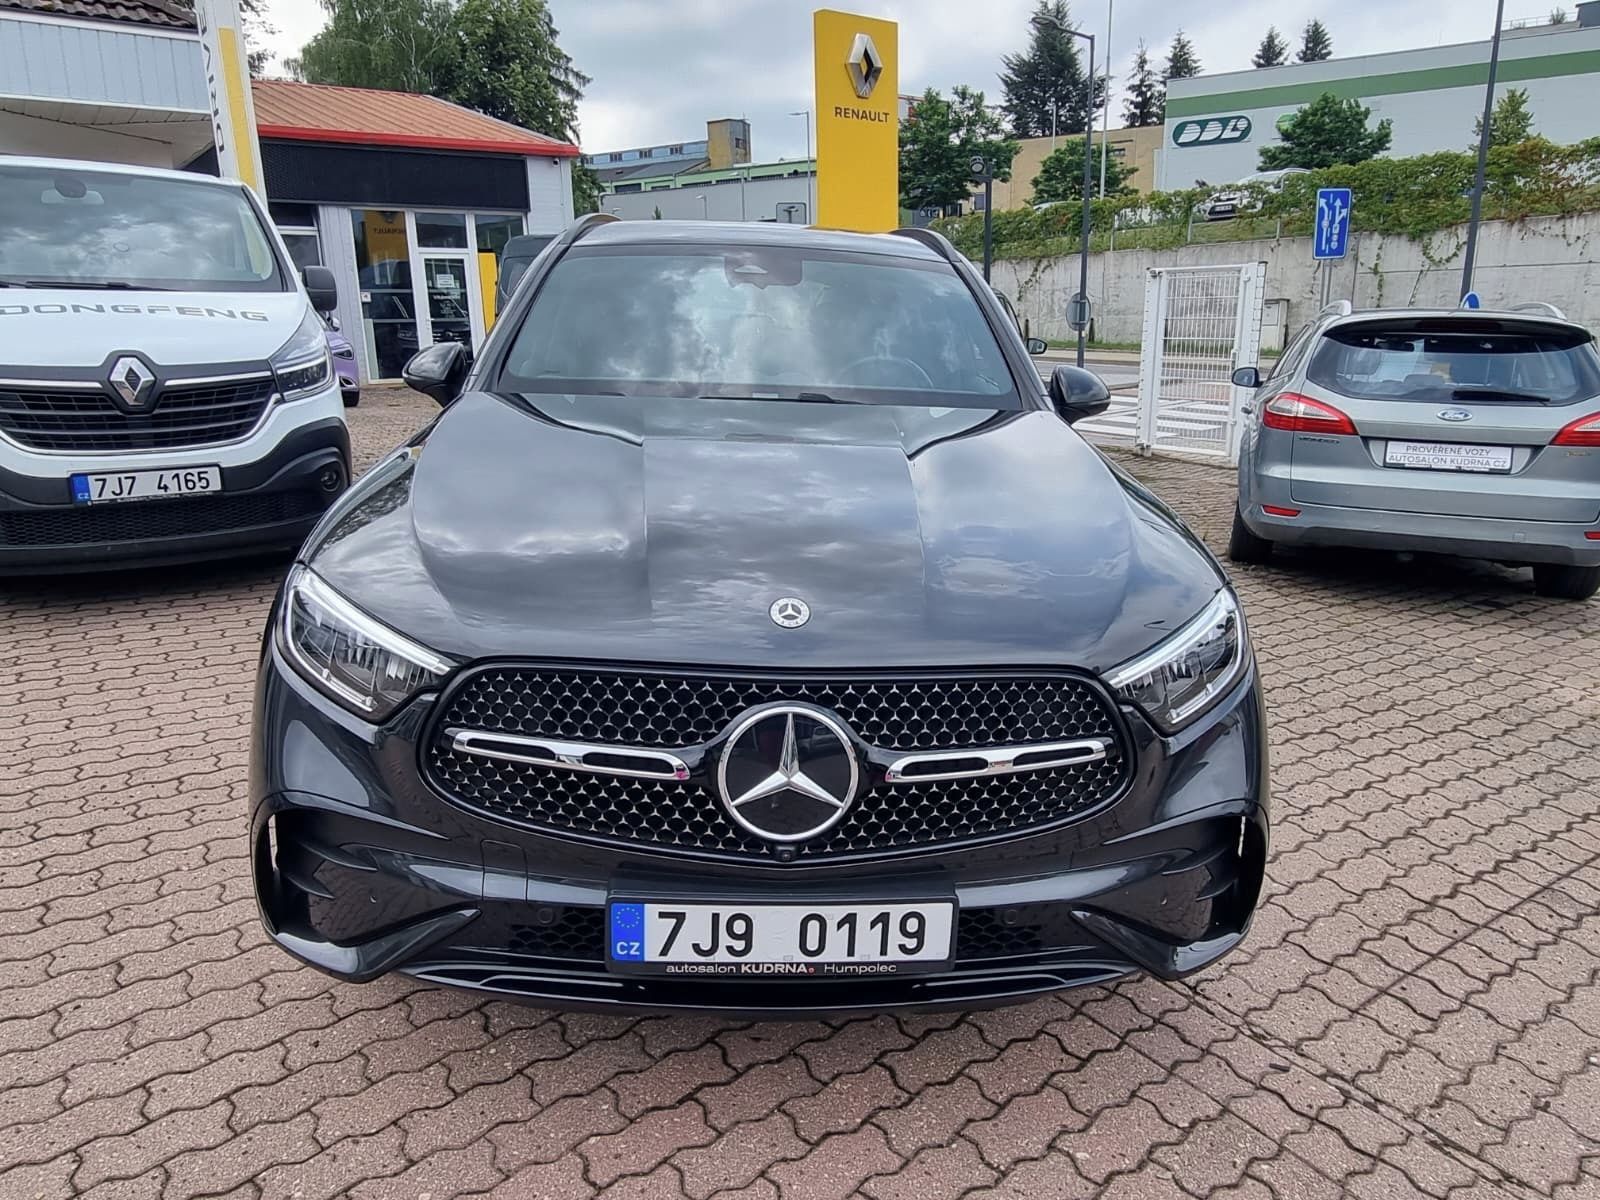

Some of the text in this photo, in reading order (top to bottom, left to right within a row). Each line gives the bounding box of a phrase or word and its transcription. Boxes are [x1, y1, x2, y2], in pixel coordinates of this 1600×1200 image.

[834, 106, 890, 123] RENAULT
[0, 304, 269, 322] DONGFENG
[1388, 455, 1447, 464] AUTOSALON
[1449, 457, 1490, 467] KUDRNA
[94, 470, 210, 498] 7J7 4165
[658, 911, 926, 958] 7J9 0119
[616, 942, 640, 955] CZ
[666, 964, 736, 974] autosalon
[824, 963, 897, 975] Humpolec
